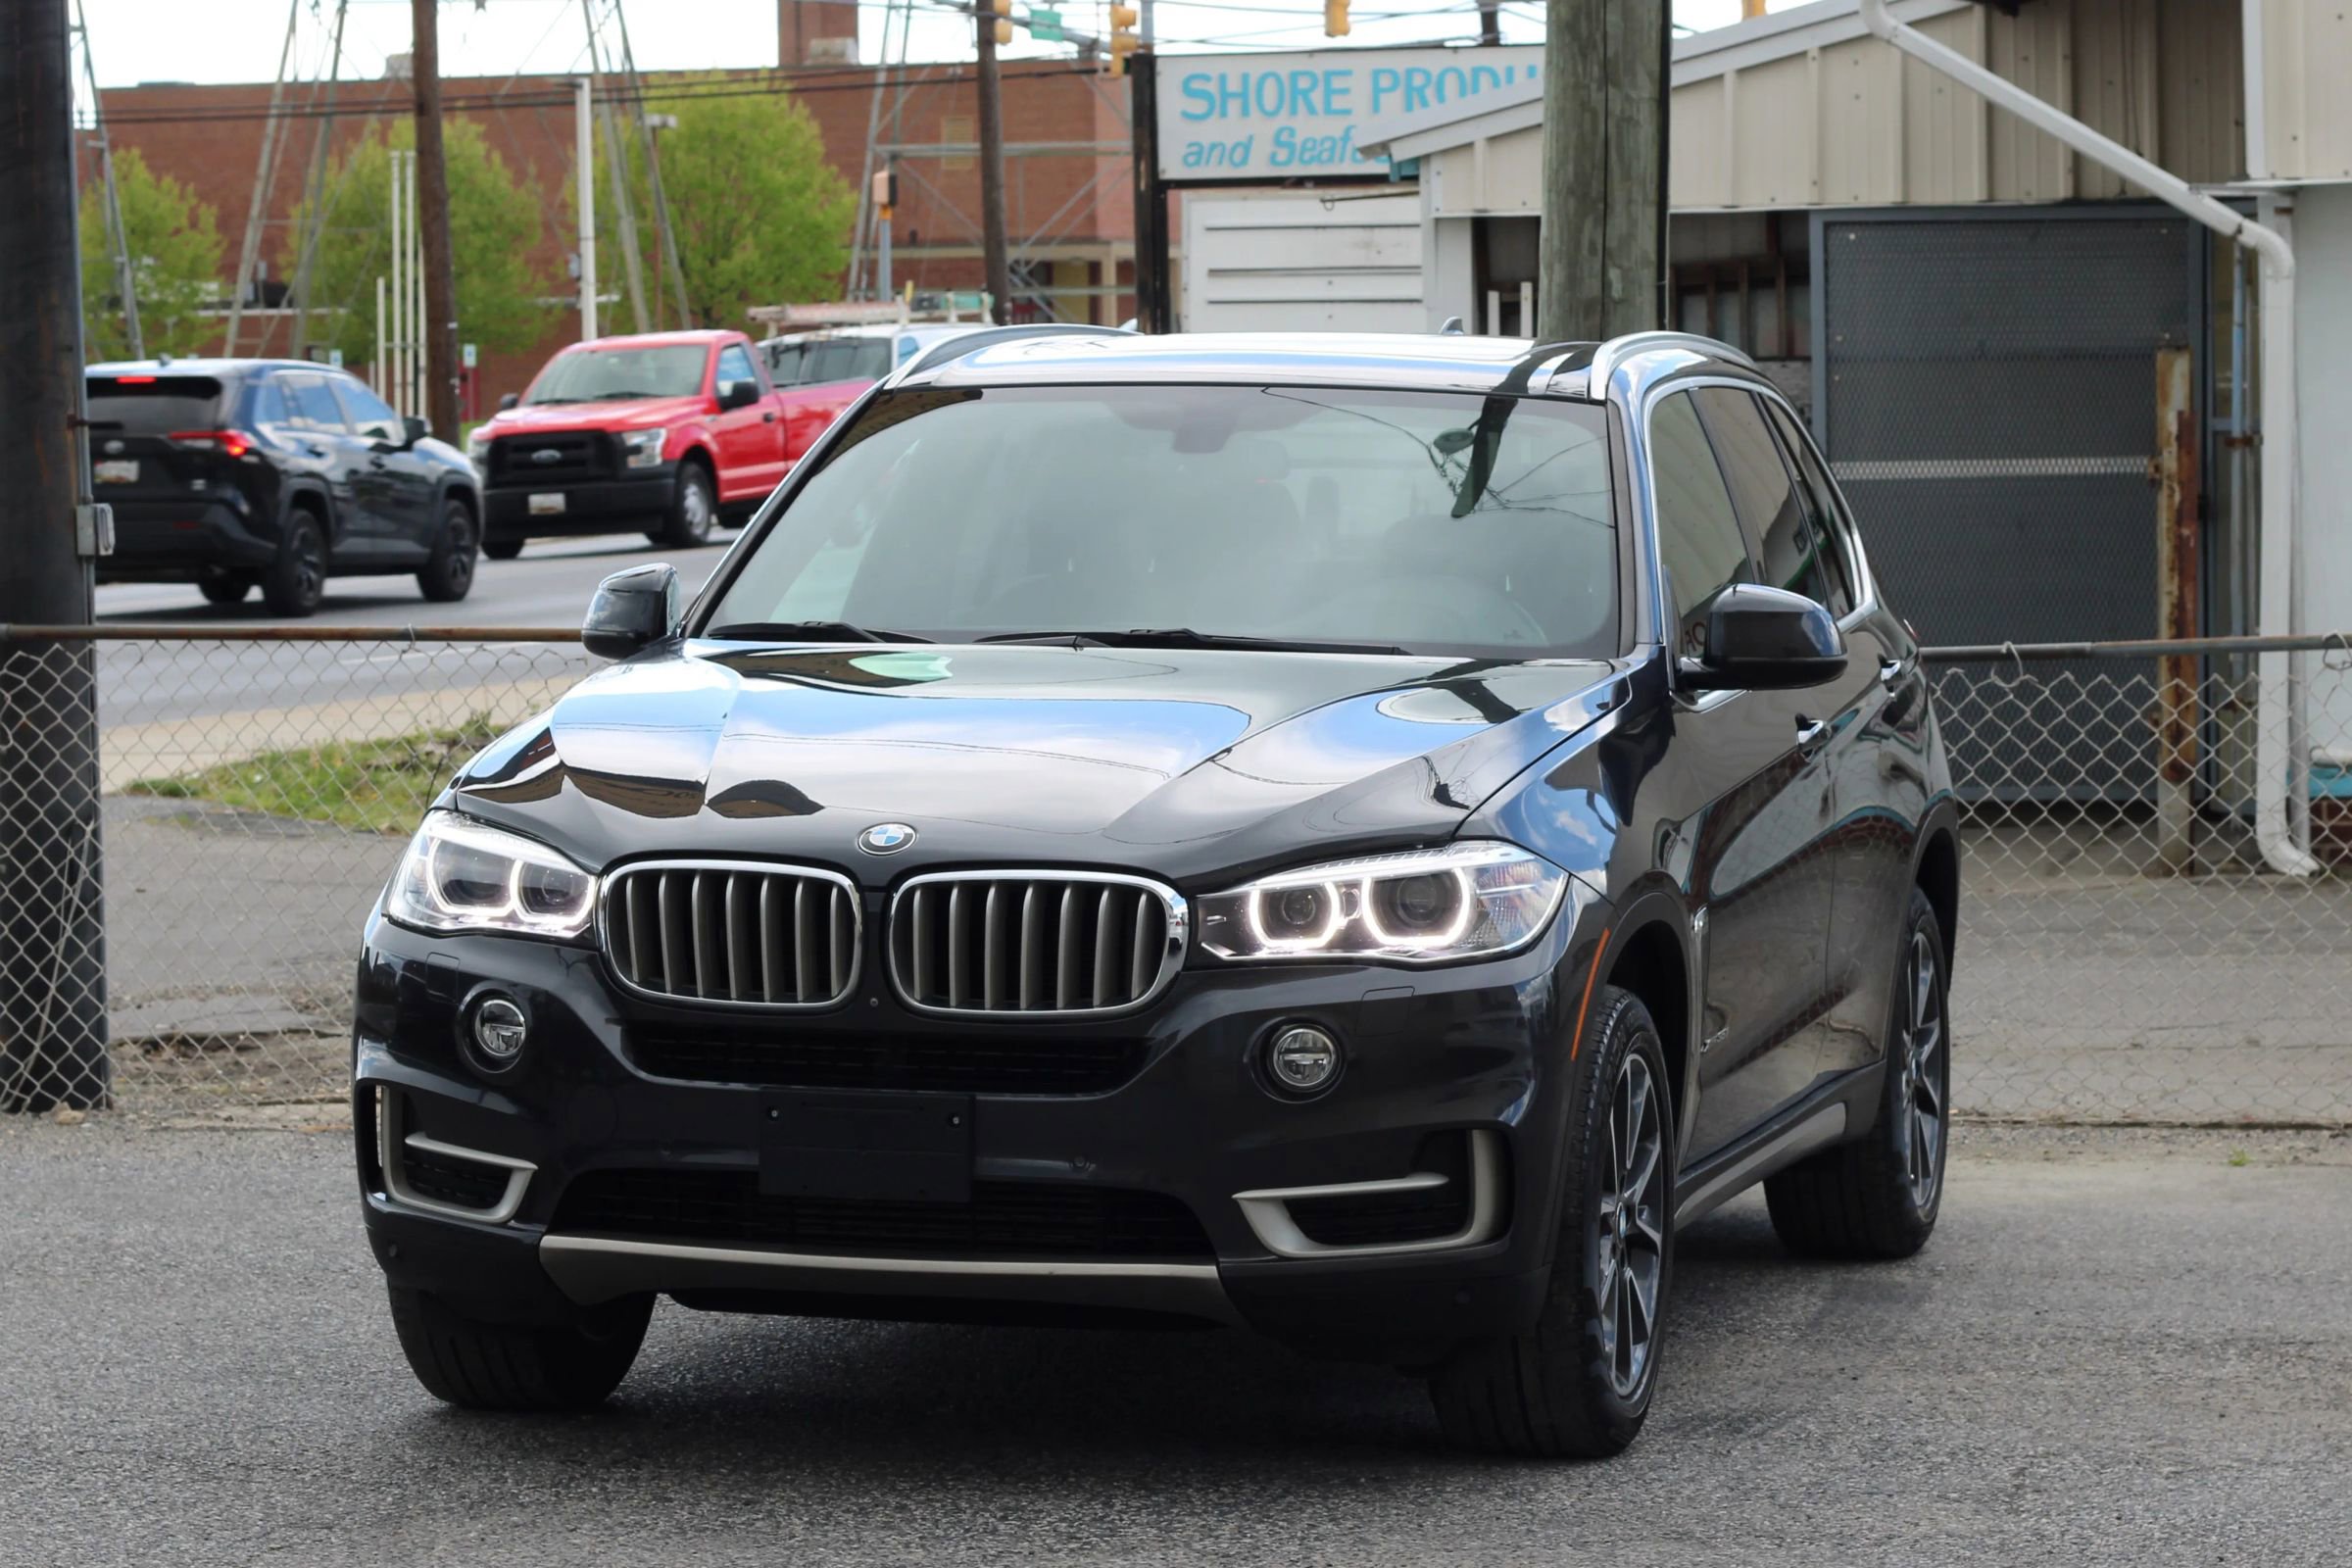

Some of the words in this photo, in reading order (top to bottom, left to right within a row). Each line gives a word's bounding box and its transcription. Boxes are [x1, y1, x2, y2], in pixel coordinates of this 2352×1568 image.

[1180, 70, 1354, 122] SHORE
[1372, 65, 1538, 114] PROD
[1182, 133, 1254, 169] and
